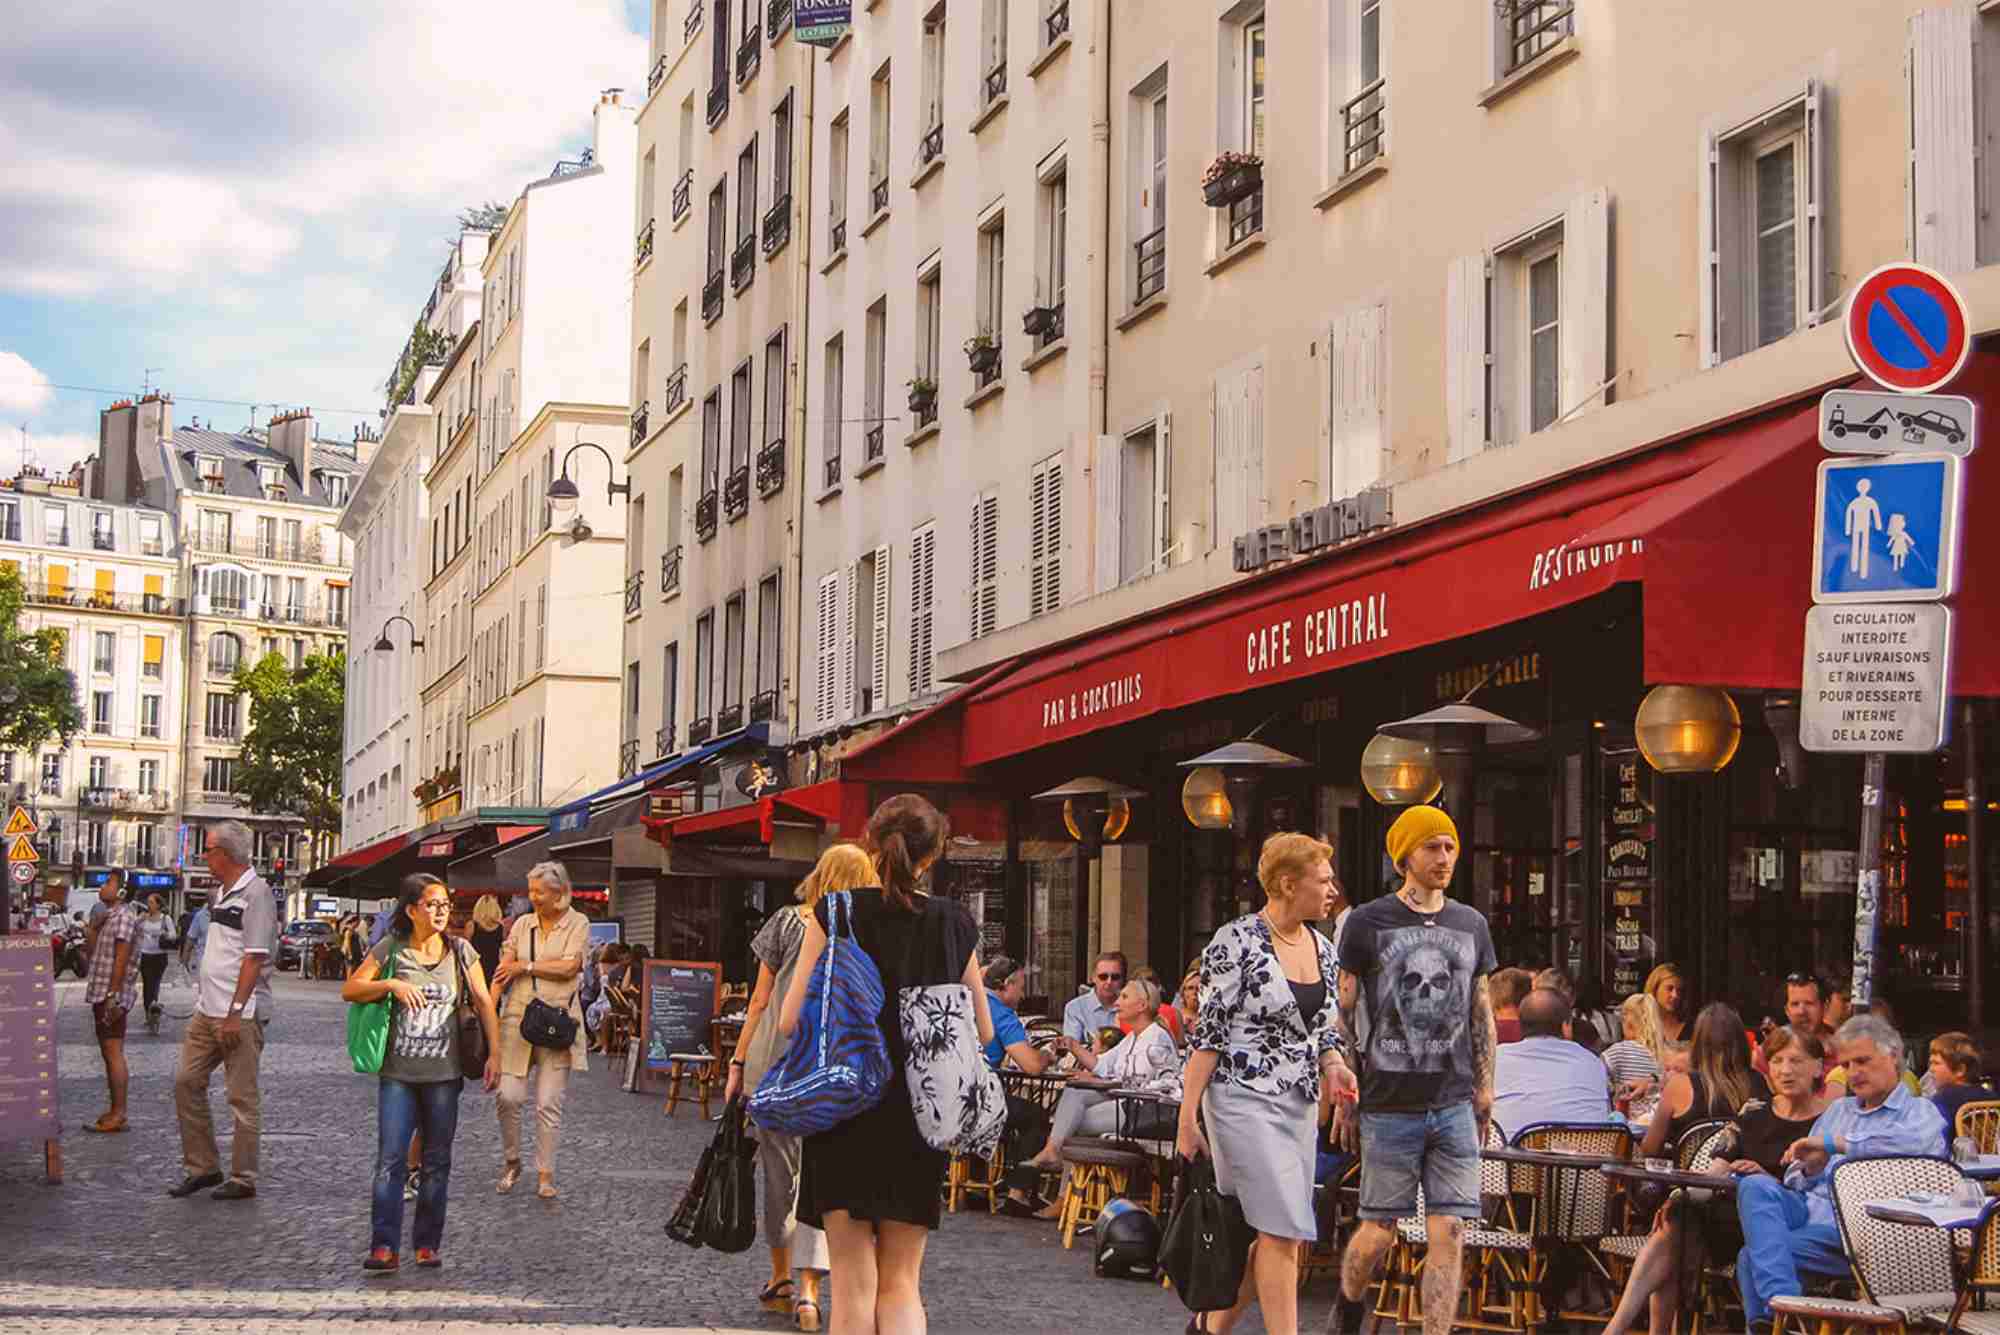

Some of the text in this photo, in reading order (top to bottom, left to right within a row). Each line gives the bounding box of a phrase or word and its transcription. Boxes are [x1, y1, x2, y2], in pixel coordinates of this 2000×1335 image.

[1832, 612, 1916, 625] CIRCULATION
[1247, 592, 1389, 674] CAFE CENTRAL
[1841, 632, 1908, 644] INTERDITE
[1816, 651, 1931, 663] SAUF LIVRAISONS
[1828, 671, 1916, 683] ET RIVERAINS
[1082, 673, 1142, 717] COCKTAILS
[1819, 690, 1922, 702] POUR DESSERTE
[1842, 710, 1896, 721] INTERNE
[1832, 729, 1904, 741] DE LA ZONE
